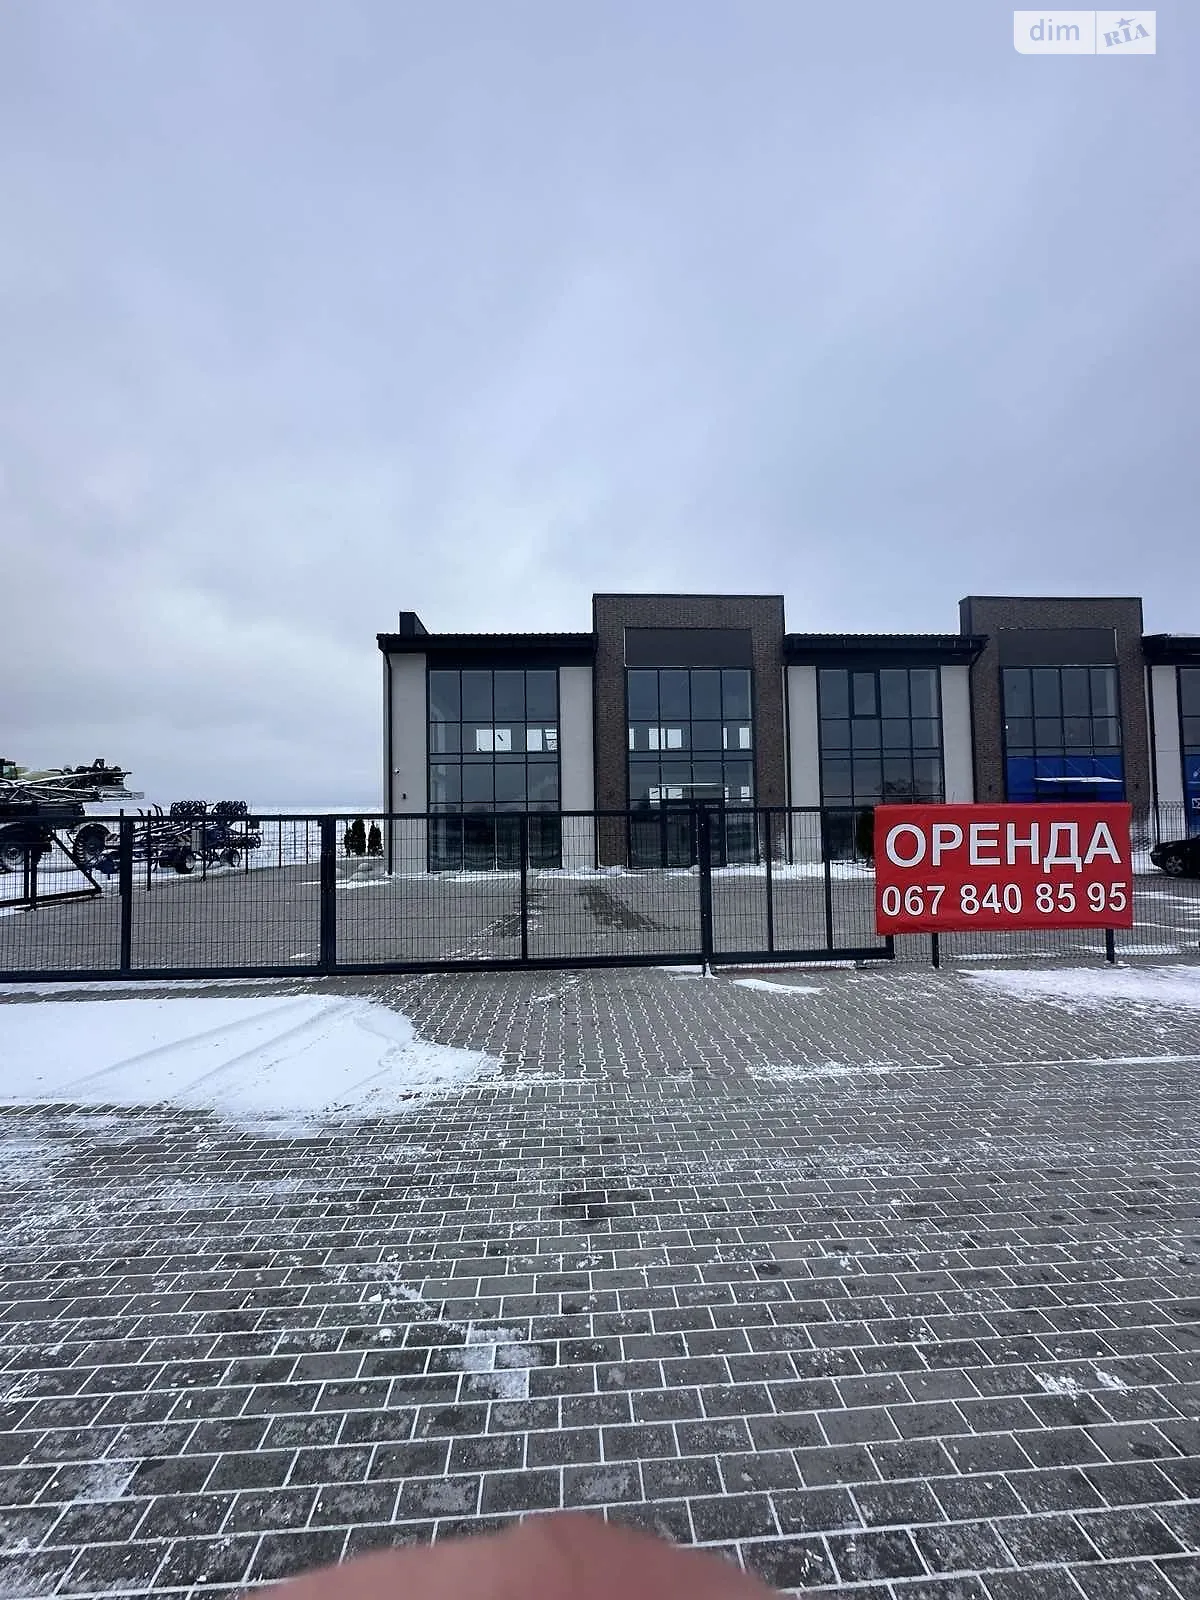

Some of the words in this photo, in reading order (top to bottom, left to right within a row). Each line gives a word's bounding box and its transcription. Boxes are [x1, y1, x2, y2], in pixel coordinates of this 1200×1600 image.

[885, 822, 1122, 873] ОРЕНДА
[881, 885, 946, 916] 067
[959, 883, 1023, 915] 840
[1035, 883, 1076, 914] 85
[1086, 882, 1127, 912] 95
